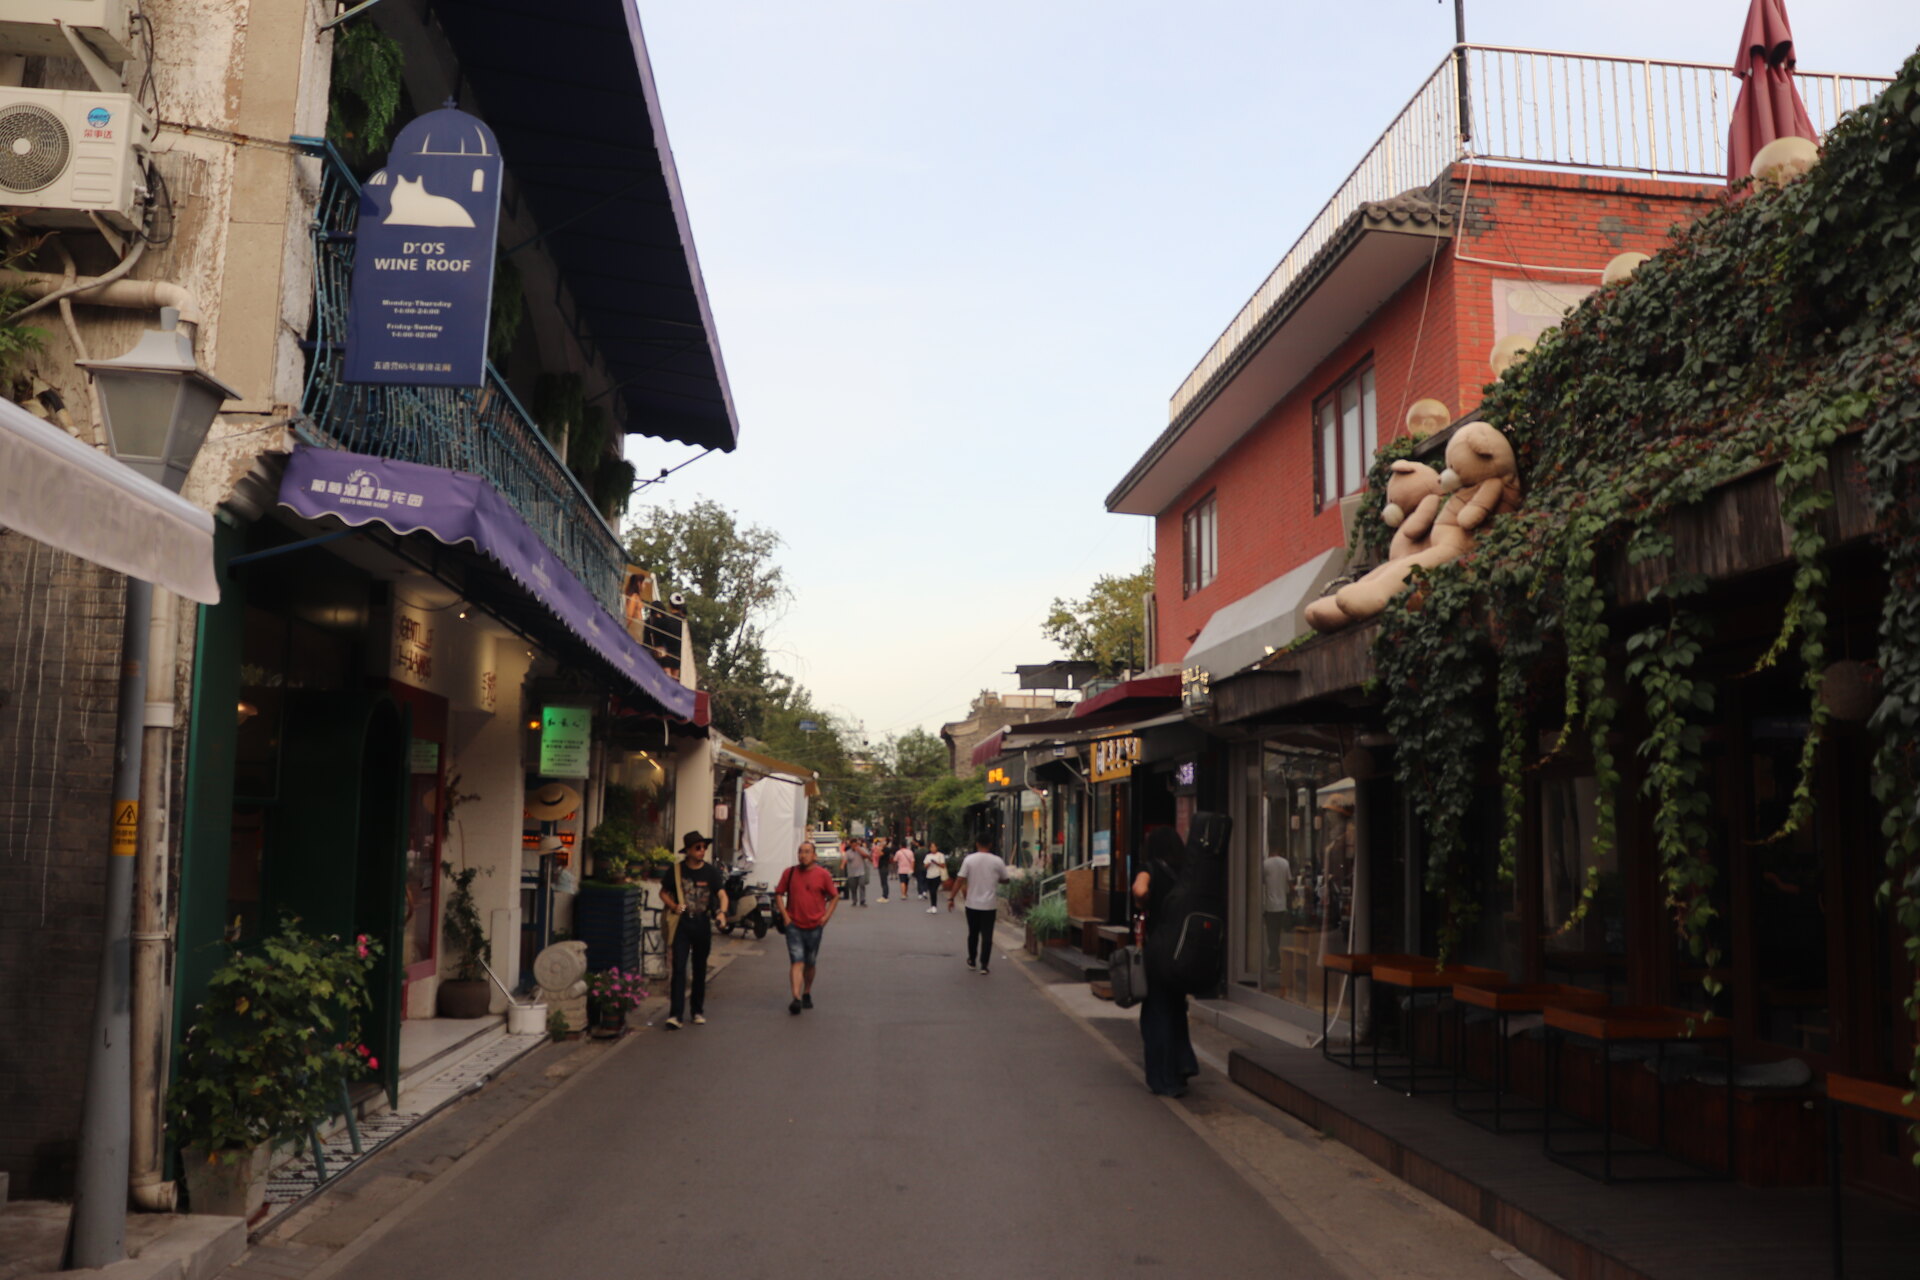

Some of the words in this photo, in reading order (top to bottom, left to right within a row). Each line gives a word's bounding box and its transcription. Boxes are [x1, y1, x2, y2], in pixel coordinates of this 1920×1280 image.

[374, 258, 418, 271] WINE
[425, 258, 471, 272] ROOF
[311, 478, 424, 508] 葡萄酒屋顶花园
